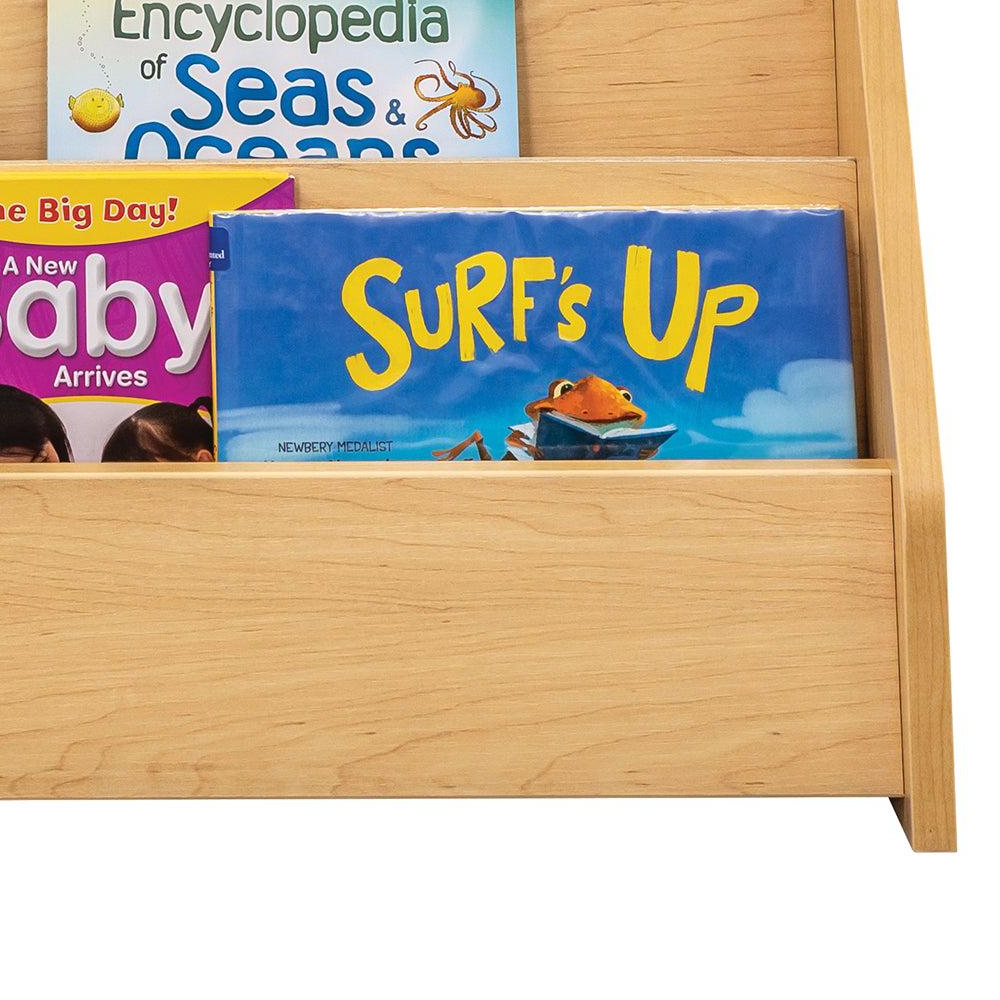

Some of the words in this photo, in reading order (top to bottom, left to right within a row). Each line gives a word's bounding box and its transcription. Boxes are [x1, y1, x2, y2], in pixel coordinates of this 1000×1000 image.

[140, 53, 168, 80] of
[170, 53, 376, 132] Seas
[386, 98, 406, 125] &
[38, 197, 93, 230] Big
[103, 197, 180, 230] Day!
[2, 256, 20, 275] A
[25, 256, 78, 276] New
[53, 365, 148, 388] Arrives
[278, 441, 333, 453] NEWBERY
[337, 440, 393, 453] MEDALIST
